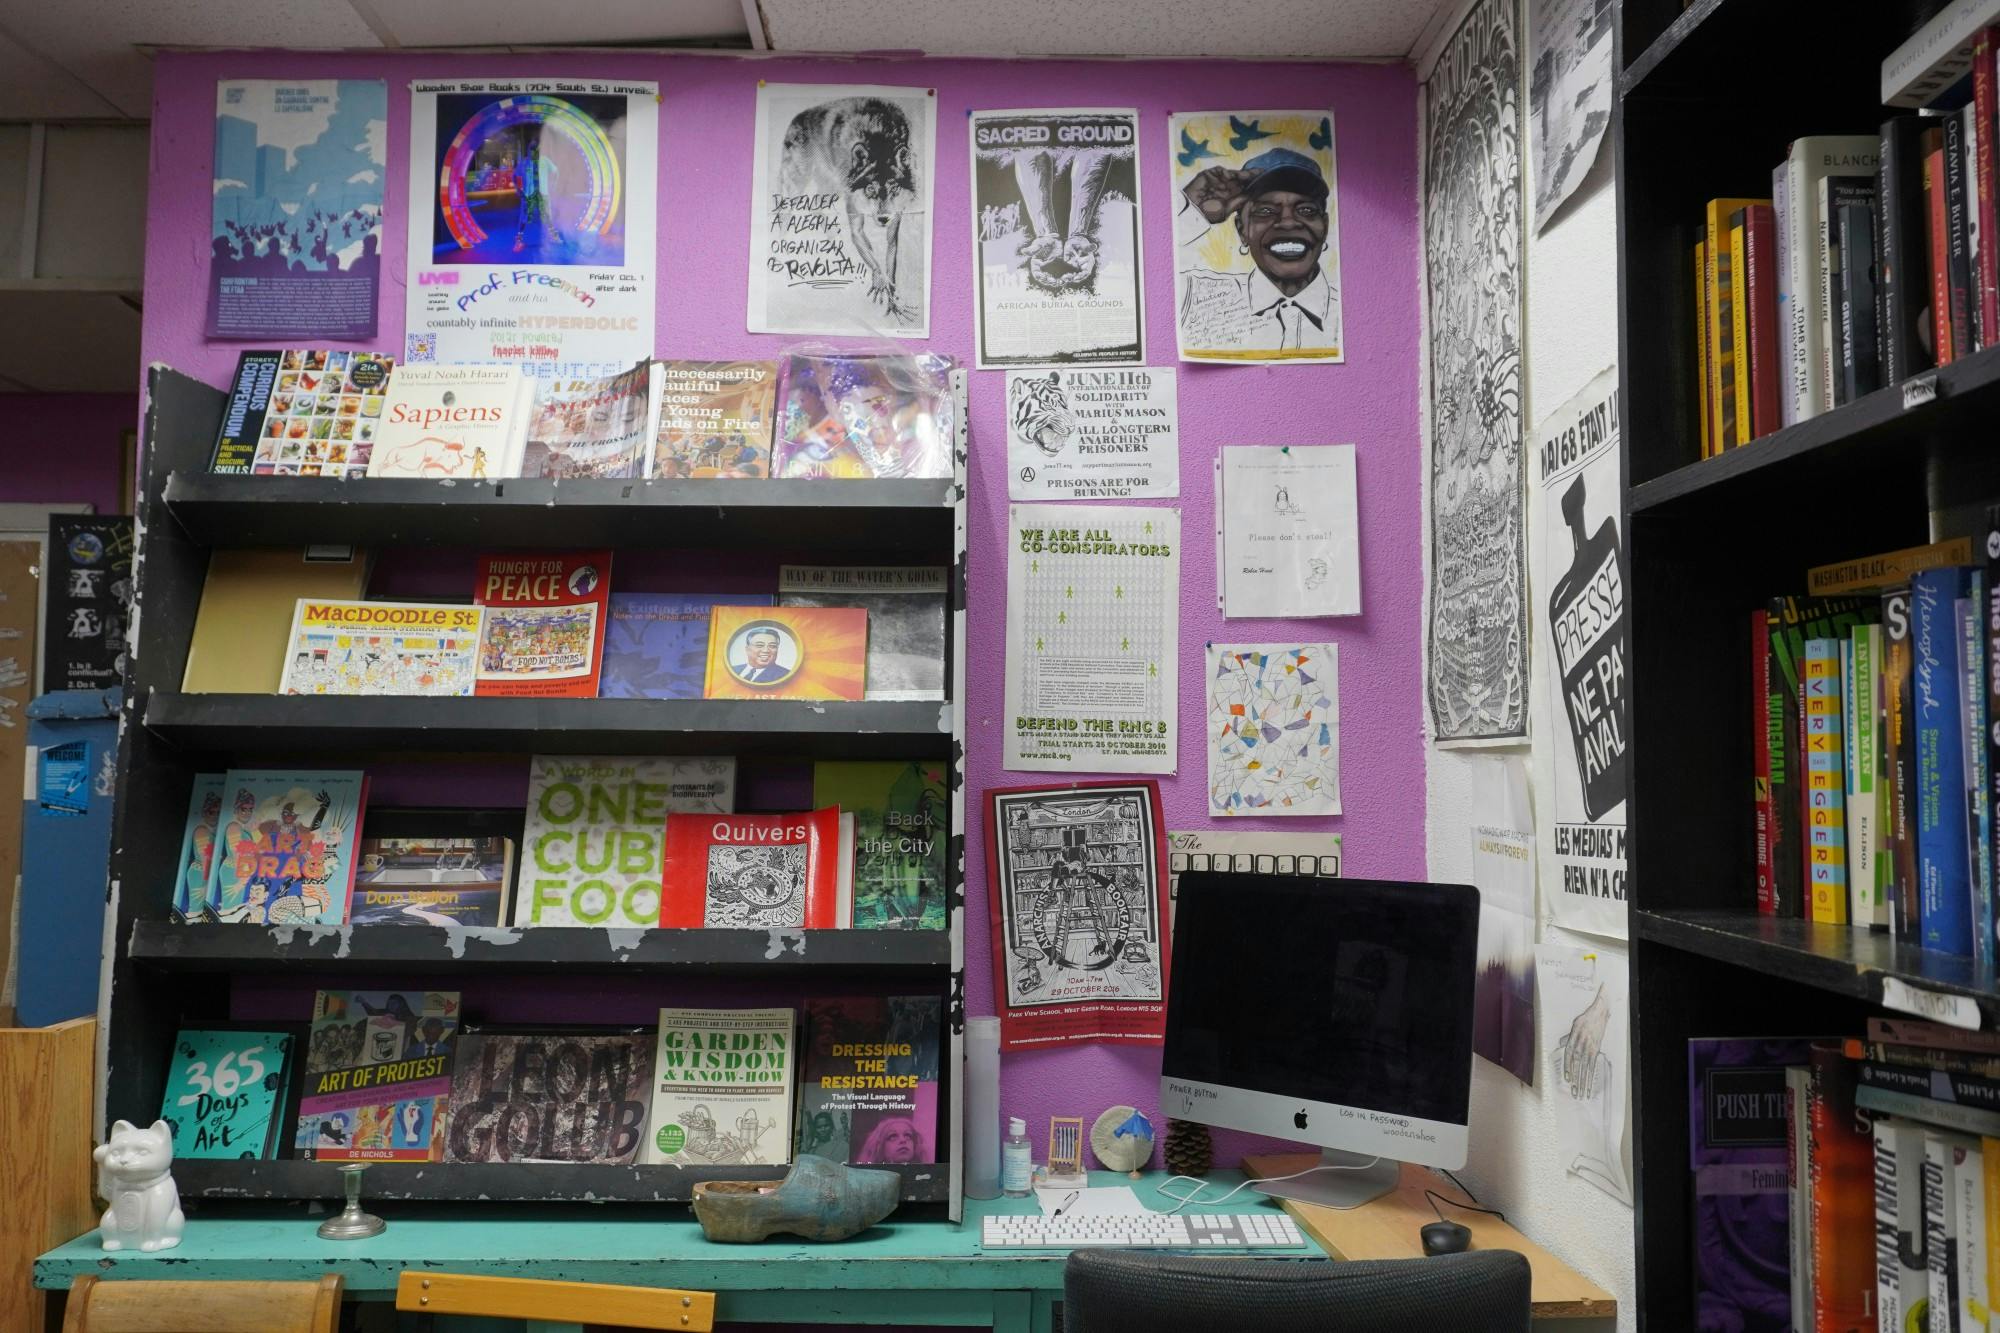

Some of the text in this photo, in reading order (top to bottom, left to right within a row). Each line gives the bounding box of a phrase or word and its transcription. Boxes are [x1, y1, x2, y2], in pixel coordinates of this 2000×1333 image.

[415, 84, 455, 93] Wooden
[459, 83, 484, 92] Shoe
[488, 82, 521, 92] Books
[555, 82, 586, 93] South
[977, 125, 1133, 144] SACRED GROUND
[1978, 116, 1991, 201] the Deluge
[1948, 119, 1962, 257] OCTAVIA BUTLER
[771, 193, 840, 212] DEFENDER
[770, 213, 782, 232] A
[771, 239, 846, 260] ORGANIZAR
[589, 273, 615, 282] Friday
[595, 285, 637, 293] after dark
[508, 294, 527, 303] and
[996, 300, 1124, 311] AFRICAN BURIAL GROUNDS
[1820, 221, 1832, 390] NEARLY NOWHERE SUMMER
[427, 316, 639, 331] countably infinite HYPERBOLIC
[1842, 300, 1852, 368] GRIEVERS
[1798, 307, 1808, 395] TOMB OF THE
[400, 369, 509, 380] Yuval Noah Harari
[1067, 372, 1115, 386] JUNE
[249, 362, 278, 411] CURIOUS
[224, 362, 259, 437] COMPENDIUM
[1075, 392, 1149, 402] SOLIDARITY
[389, 402, 503, 430] Sapiens
[668, 404, 724, 419] Young
[1075, 408, 1167, 418] MARIUS MASON
[696, 418, 761, 430] on Fire
[1076, 424, 1172, 435] ALL LONGTERM
[1078, 434, 1149, 445] ANARCHIST
[1541, 400, 1608, 481] MAI 68 ÉTAIT
[1078, 444, 1149, 454] PRISONERS
[213, 466, 249, 474] SKILLS
[1047, 478, 1150, 488] PRISONS ARE FOR
[1074, 488, 1132, 498] BURNING!
[1020, 528, 1112, 541] WE ARE ALL
[1019, 541, 1172, 556] CO-CONSPIRATORS
[489, 560, 564, 574] HUNGRY FOR
[785, 569, 940, 583] WAY OF THE WATER'S GOING
[485, 575, 563, 601] PEACE
[452, 611, 477, 625] St.
[1555, 555, 1623, 673] PRESSE
[517, 653, 579, 666] FOOD BOMBS
[1859, 642, 1871, 733] INVISIBLE
[1570, 668, 1601, 735] NE
[1016, 716, 1168, 734] DEFEND THE RNC 8
[1038, 740, 1061, 748] TRIAL
[1107, 741, 1147, 749] OCTOBER
[1770, 693, 1785, 784] WIDEMAN
[1862, 736, 1872, 774] MAN
[545, 767, 556, 777] A
[619, 767, 636, 777] IN
[1810, 662, 1828, 879] EVERY EGGERS
[1895, 714, 1906, 841] Blues Leslie Feinberg
[1930, 728, 1940, 826] Stories Visions
[1921, 728, 1932, 832] for Better Future
[539, 781, 669, 826] ONE
[672, 791, 716, 799] BIODIVERSITY
[888, 810, 935, 827] Back
[1063, 808, 1092, 816] London
[711, 821, 807, 842] Quivers
[1757, 810, 1767, 866] JIM DODGE
[864, 837, 936, 857] the City
[1174, 833, 1203, 850] The
[1554, 827, 1570, 855] LES
[236, 855, 326, 880] DRAG
[1563, 864, 1589, 896] RIEN
[1050, 985, 1121, 996] 29 OCTOBER 2016
[665, 1031, 787, 1050] GARDEN
[831, 1043, 912, 1057] DRESSING
[665, 1050, 785, 1069] WISDOM
[854, 1059, 888, 1073] THE
[177, 1046, 265, 1107] 365
[316, 1055, 447, 1093] ART OF PROTEST
[663, 1069, 785, 1082] & KNOW-HOW
[820, 1074, 920, 1089] RESISTANCE
[831, 1093, 906, 1103] The Visual Language
[1169, 1083, 1218, 1099] POWER BUTTON
[196, 1093, 250, 1122] Days
[829, 1103, 857, 1111] Protest
[857, 1103, 888, 1111] Through
[888, 1103, 916, 1112] History
[1716, 1093, 1760, 1119] PUSH
[1369, 1113, 1410, 1128] PASSWORD
[193, 1125, 240, 1152] Art
[361, 1150, 395, 1159] NICHOLS
[1873, 1138, 1900, 1291] JOHN KING
[1924, 1154, 1948, 1277] JOHN KING
[1814, 1199, 1824, 1277] Invention
